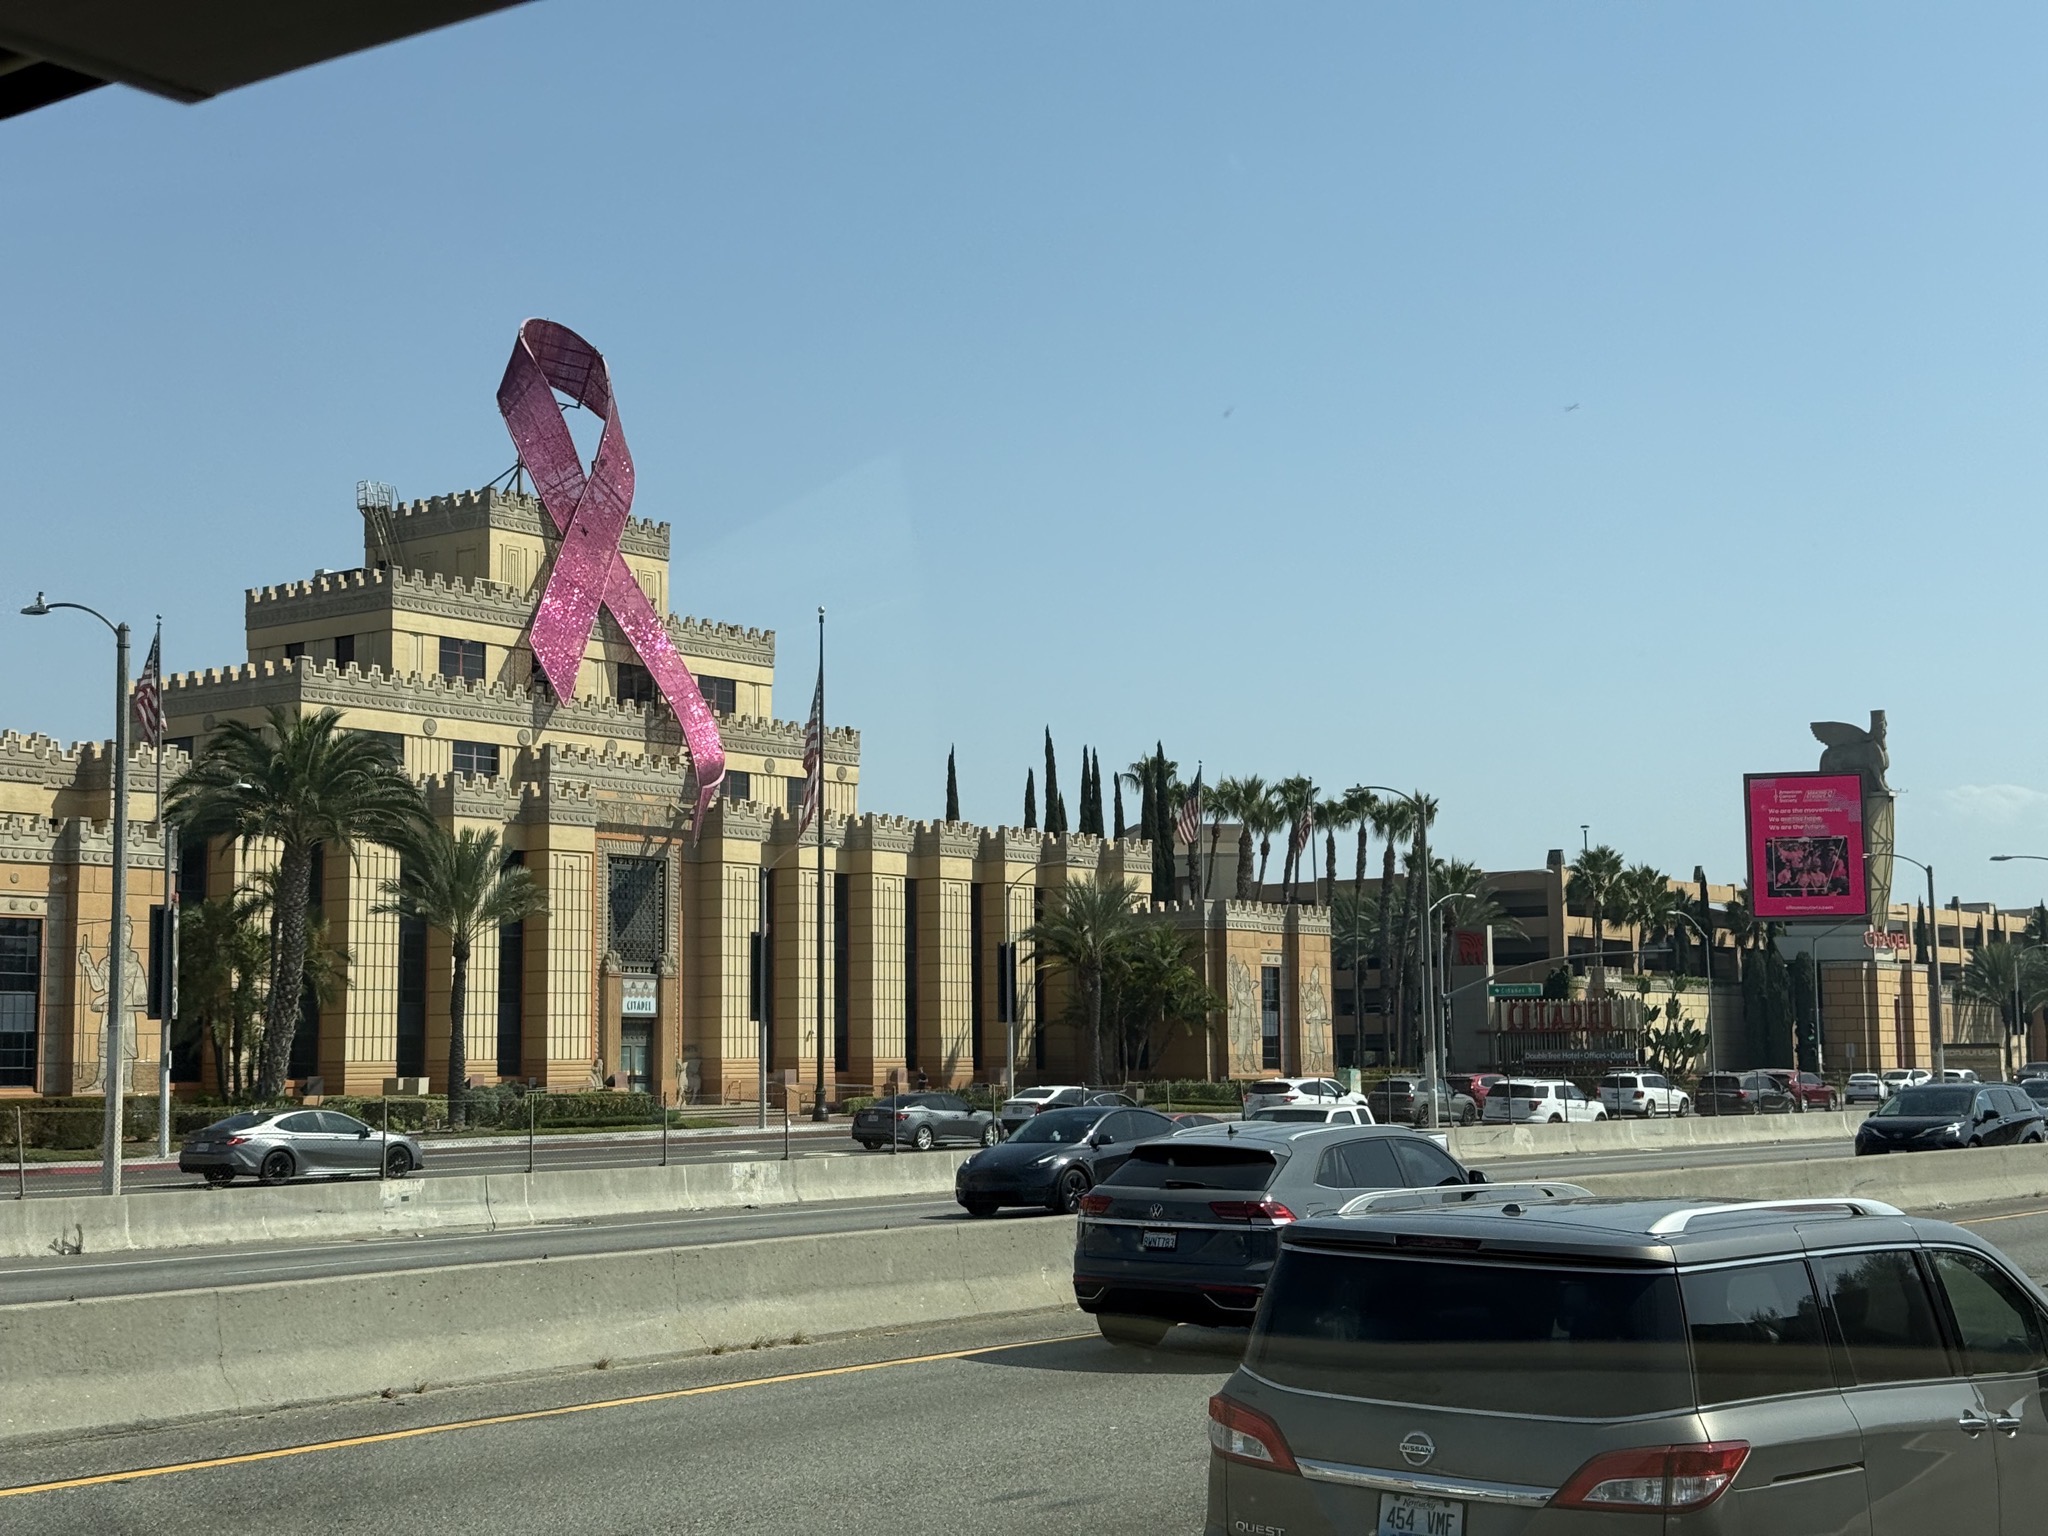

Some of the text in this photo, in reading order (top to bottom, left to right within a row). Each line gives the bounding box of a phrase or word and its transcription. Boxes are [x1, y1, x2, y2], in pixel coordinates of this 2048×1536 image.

[1863, 931, 1909, 949] CITADEL
[626, 1000, 651, 1011] CITADEL
[1507, 1001, 1614, 1032] CITADEL
[1525, 1051, 1635, 1060] DoubleTree Hotel Offices Outlets
[1401, 1444, 1433, 1454] NISSAN
[1403, 1498, 1436, 1511] Kentucky
[1235, 1520, 1286, 1536] QUEST
[1386, 1506, 1455, 1536] 454 VMF
